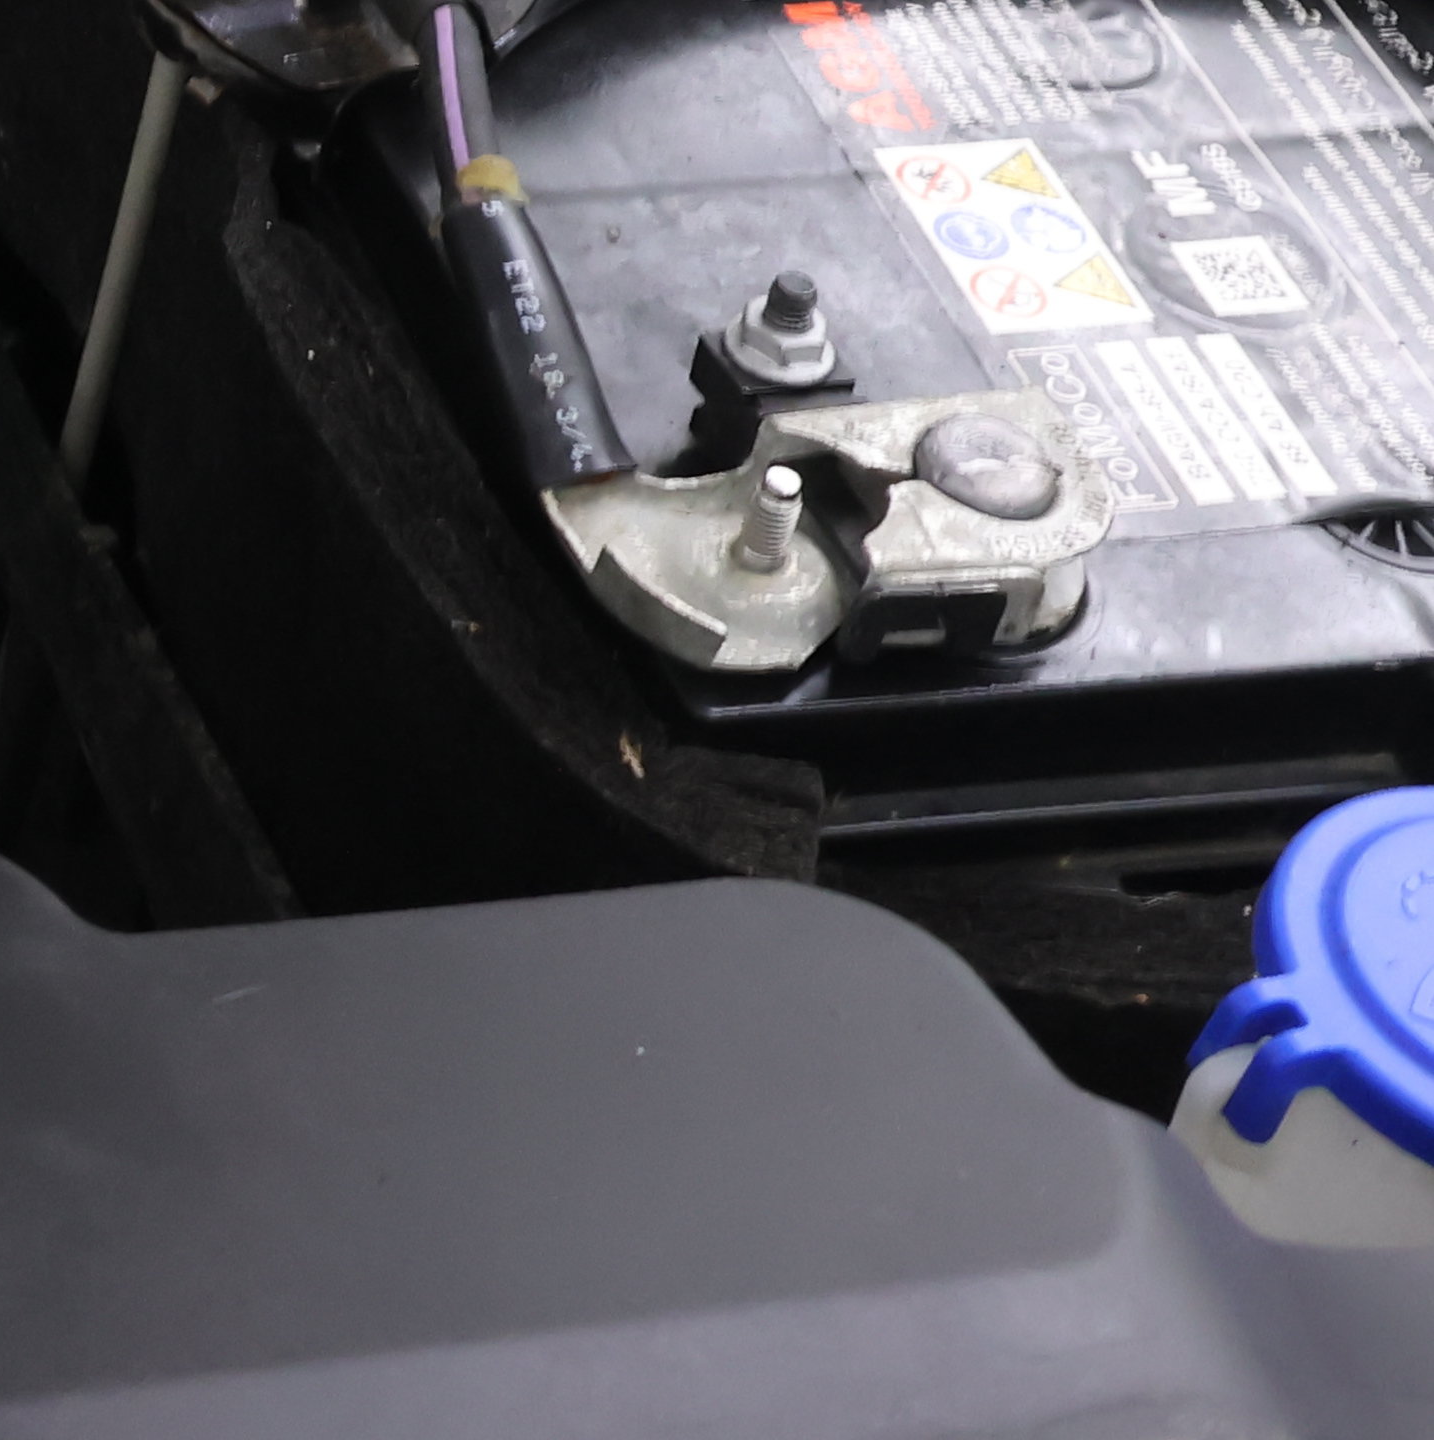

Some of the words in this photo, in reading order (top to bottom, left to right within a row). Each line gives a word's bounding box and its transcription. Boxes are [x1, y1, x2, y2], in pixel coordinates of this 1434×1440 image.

[782, 0, 915, 129] AGM
[1129, 147, 1215, 219] MF
[501, 258, 544, 338] ET22
[1042, 350, 1157, 505] FoMoCo
